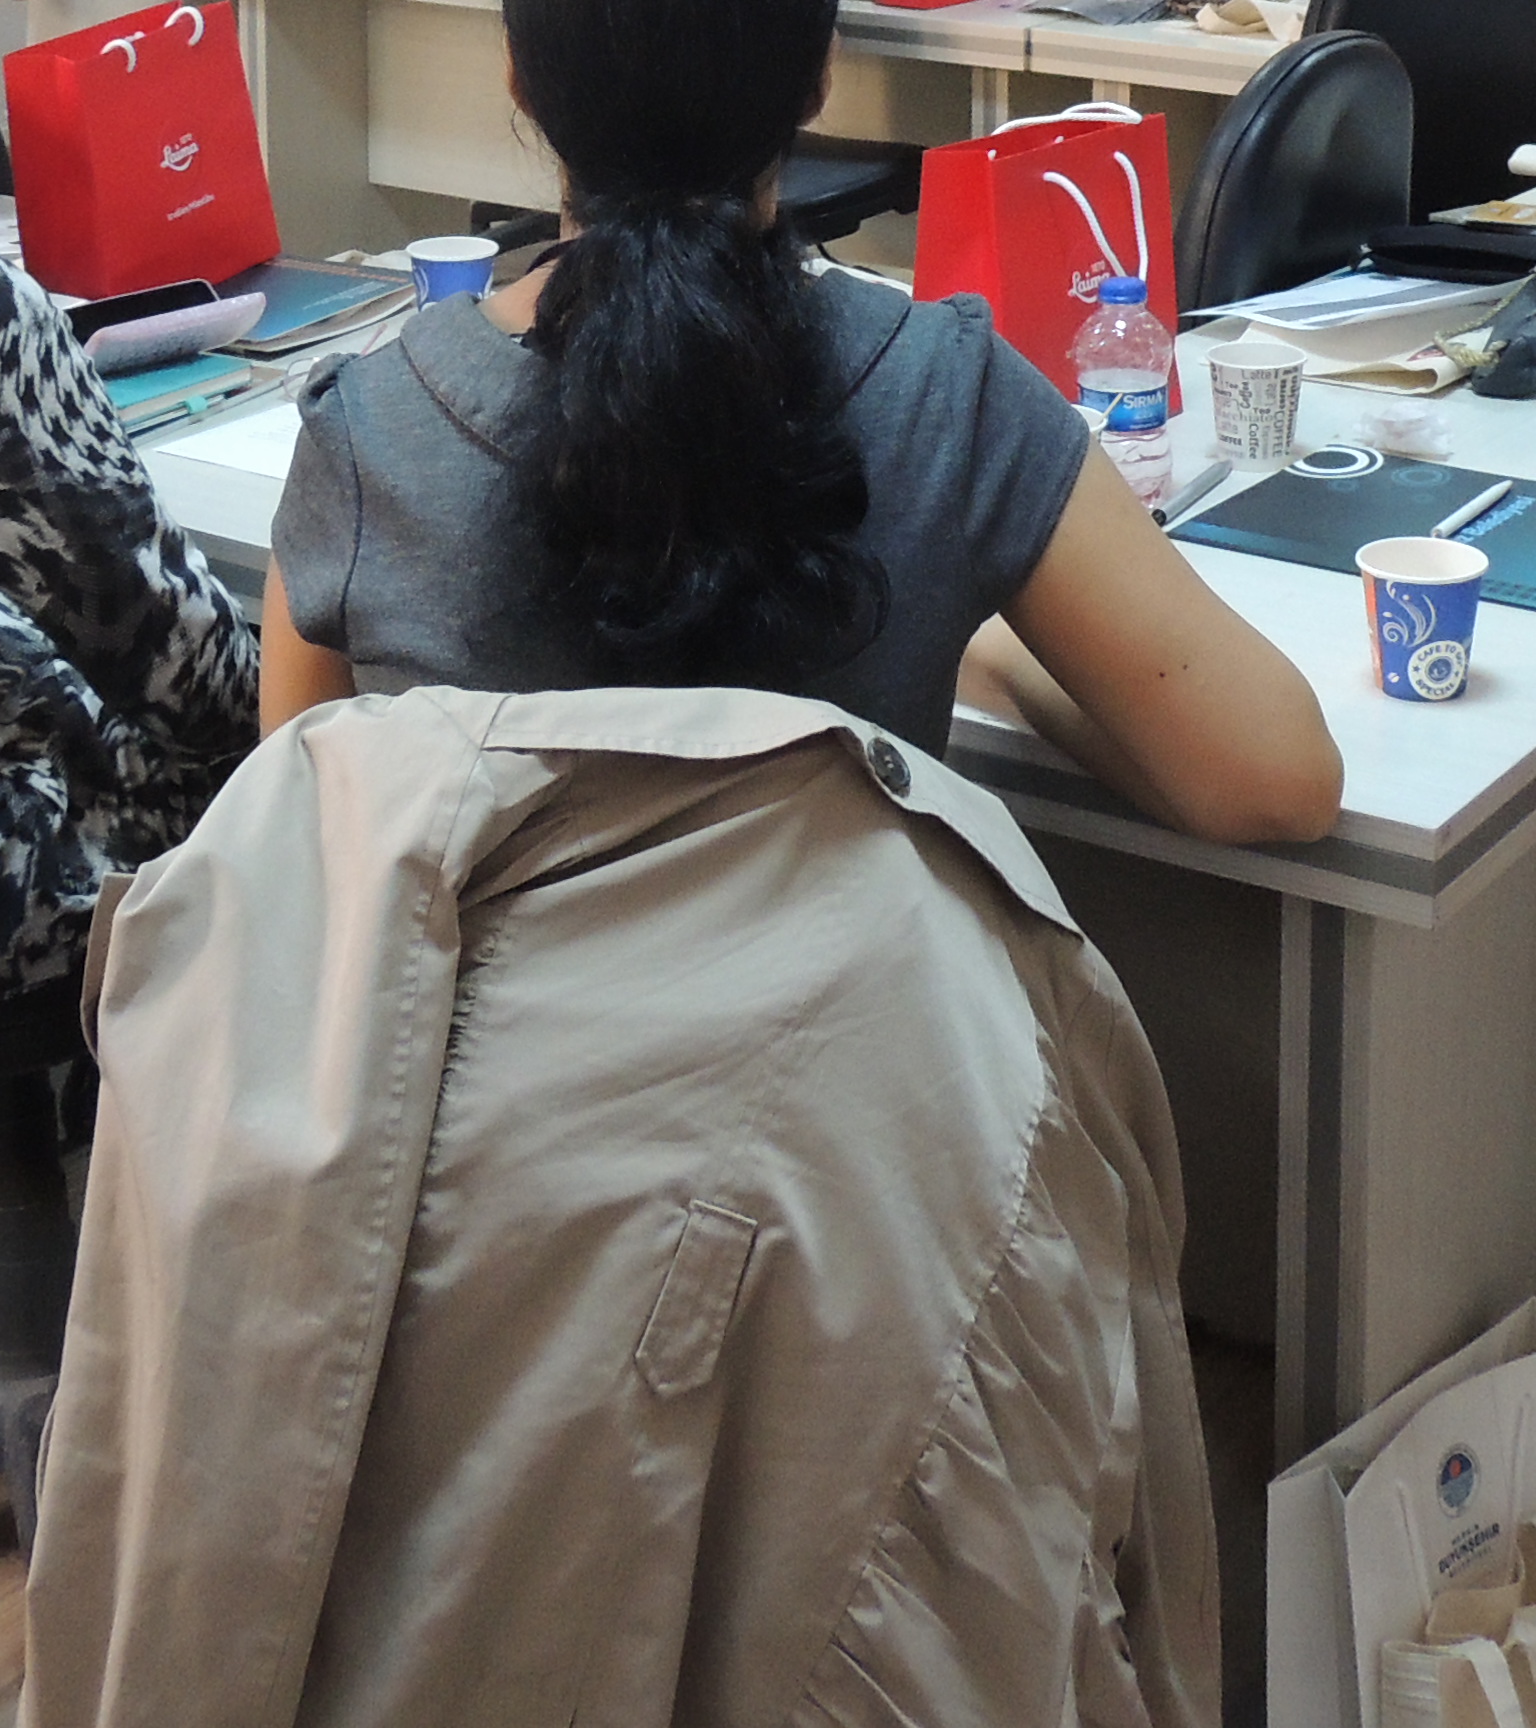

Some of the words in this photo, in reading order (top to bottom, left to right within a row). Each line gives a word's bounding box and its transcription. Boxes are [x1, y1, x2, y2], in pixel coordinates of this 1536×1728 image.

[1123, 390, 1164, 410] SIRMA
[1248, 422, 1260, 460] Coffee
[1271, 410, 1285, 458] COFFEE
[1417, 643, 1442, 662] CAFE
[1445, 643, 1457, 653] TO
[1415, 677, 1455, 697] SPECIAL
